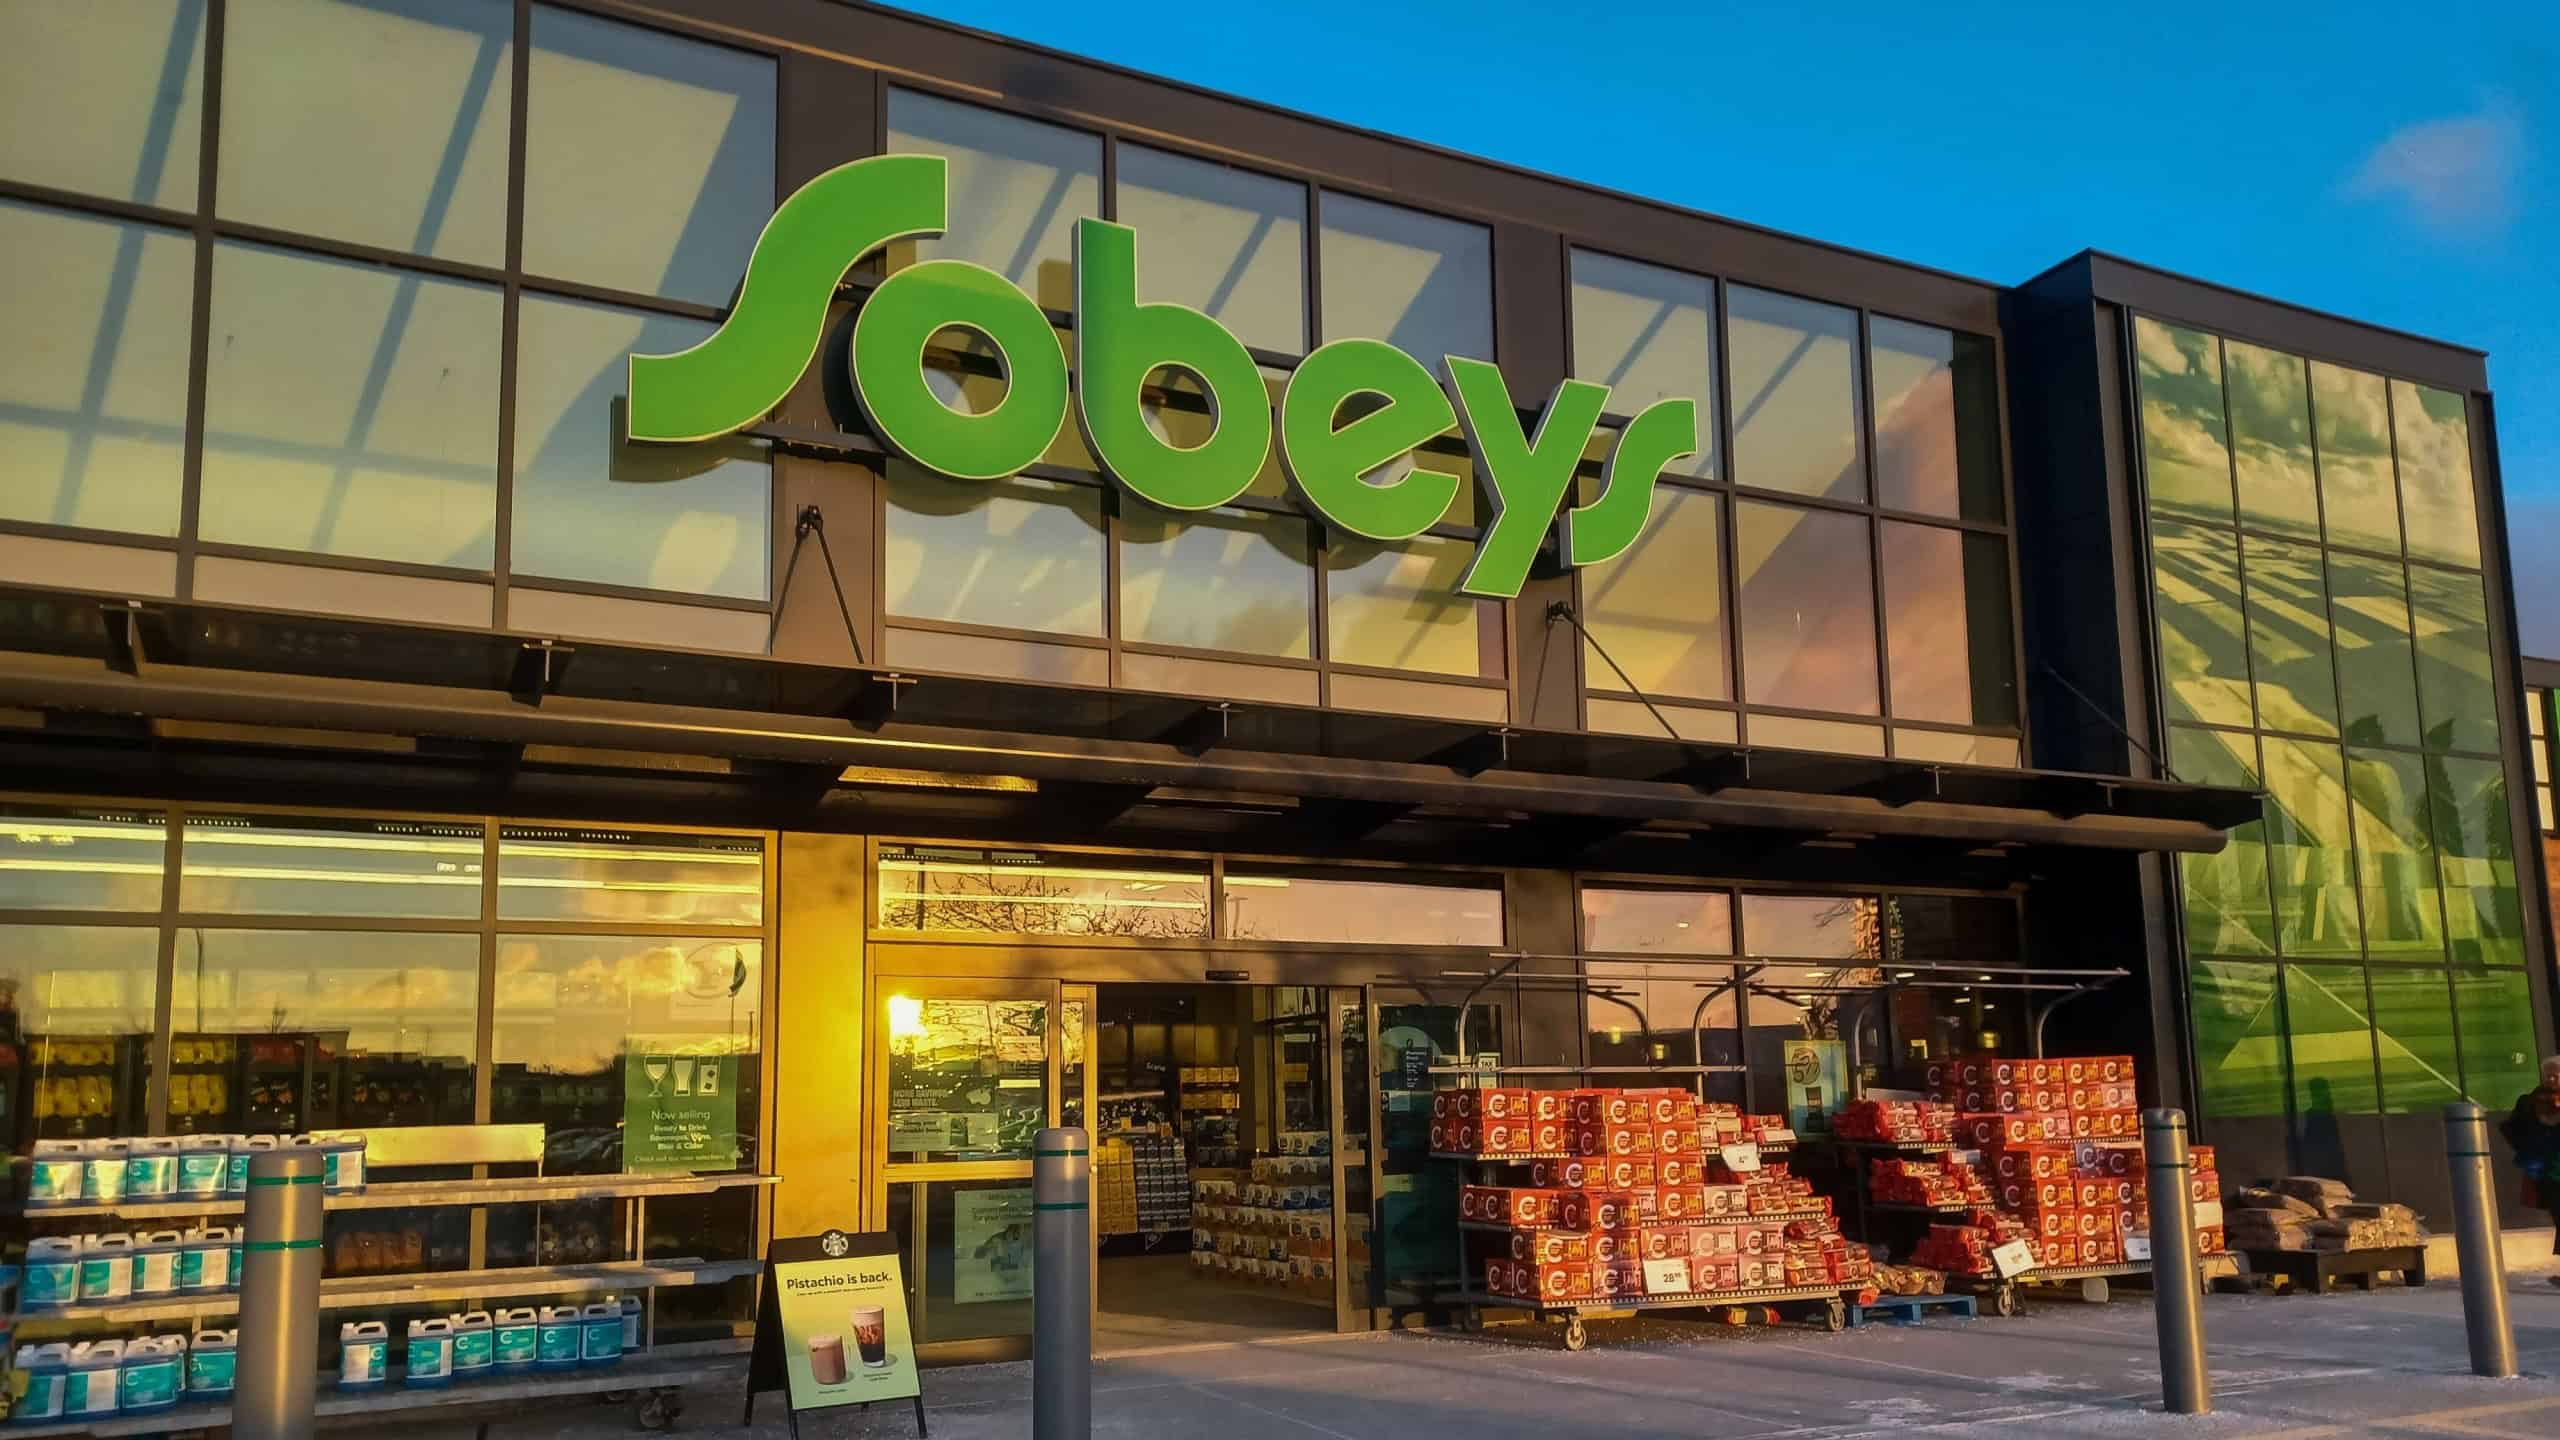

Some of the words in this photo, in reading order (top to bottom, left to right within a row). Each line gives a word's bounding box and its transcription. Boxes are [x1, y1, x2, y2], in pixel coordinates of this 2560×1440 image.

[628, 153, 1696, 599] Sobeys
[651, 1110, 675, 1120] Now
[678, 1110, 711, 1121] selling
[786, 1275, 844, 1290] Pistachio
[847, 1274, 857, 1284] is
[860, 1271, 893, 1283] back.
